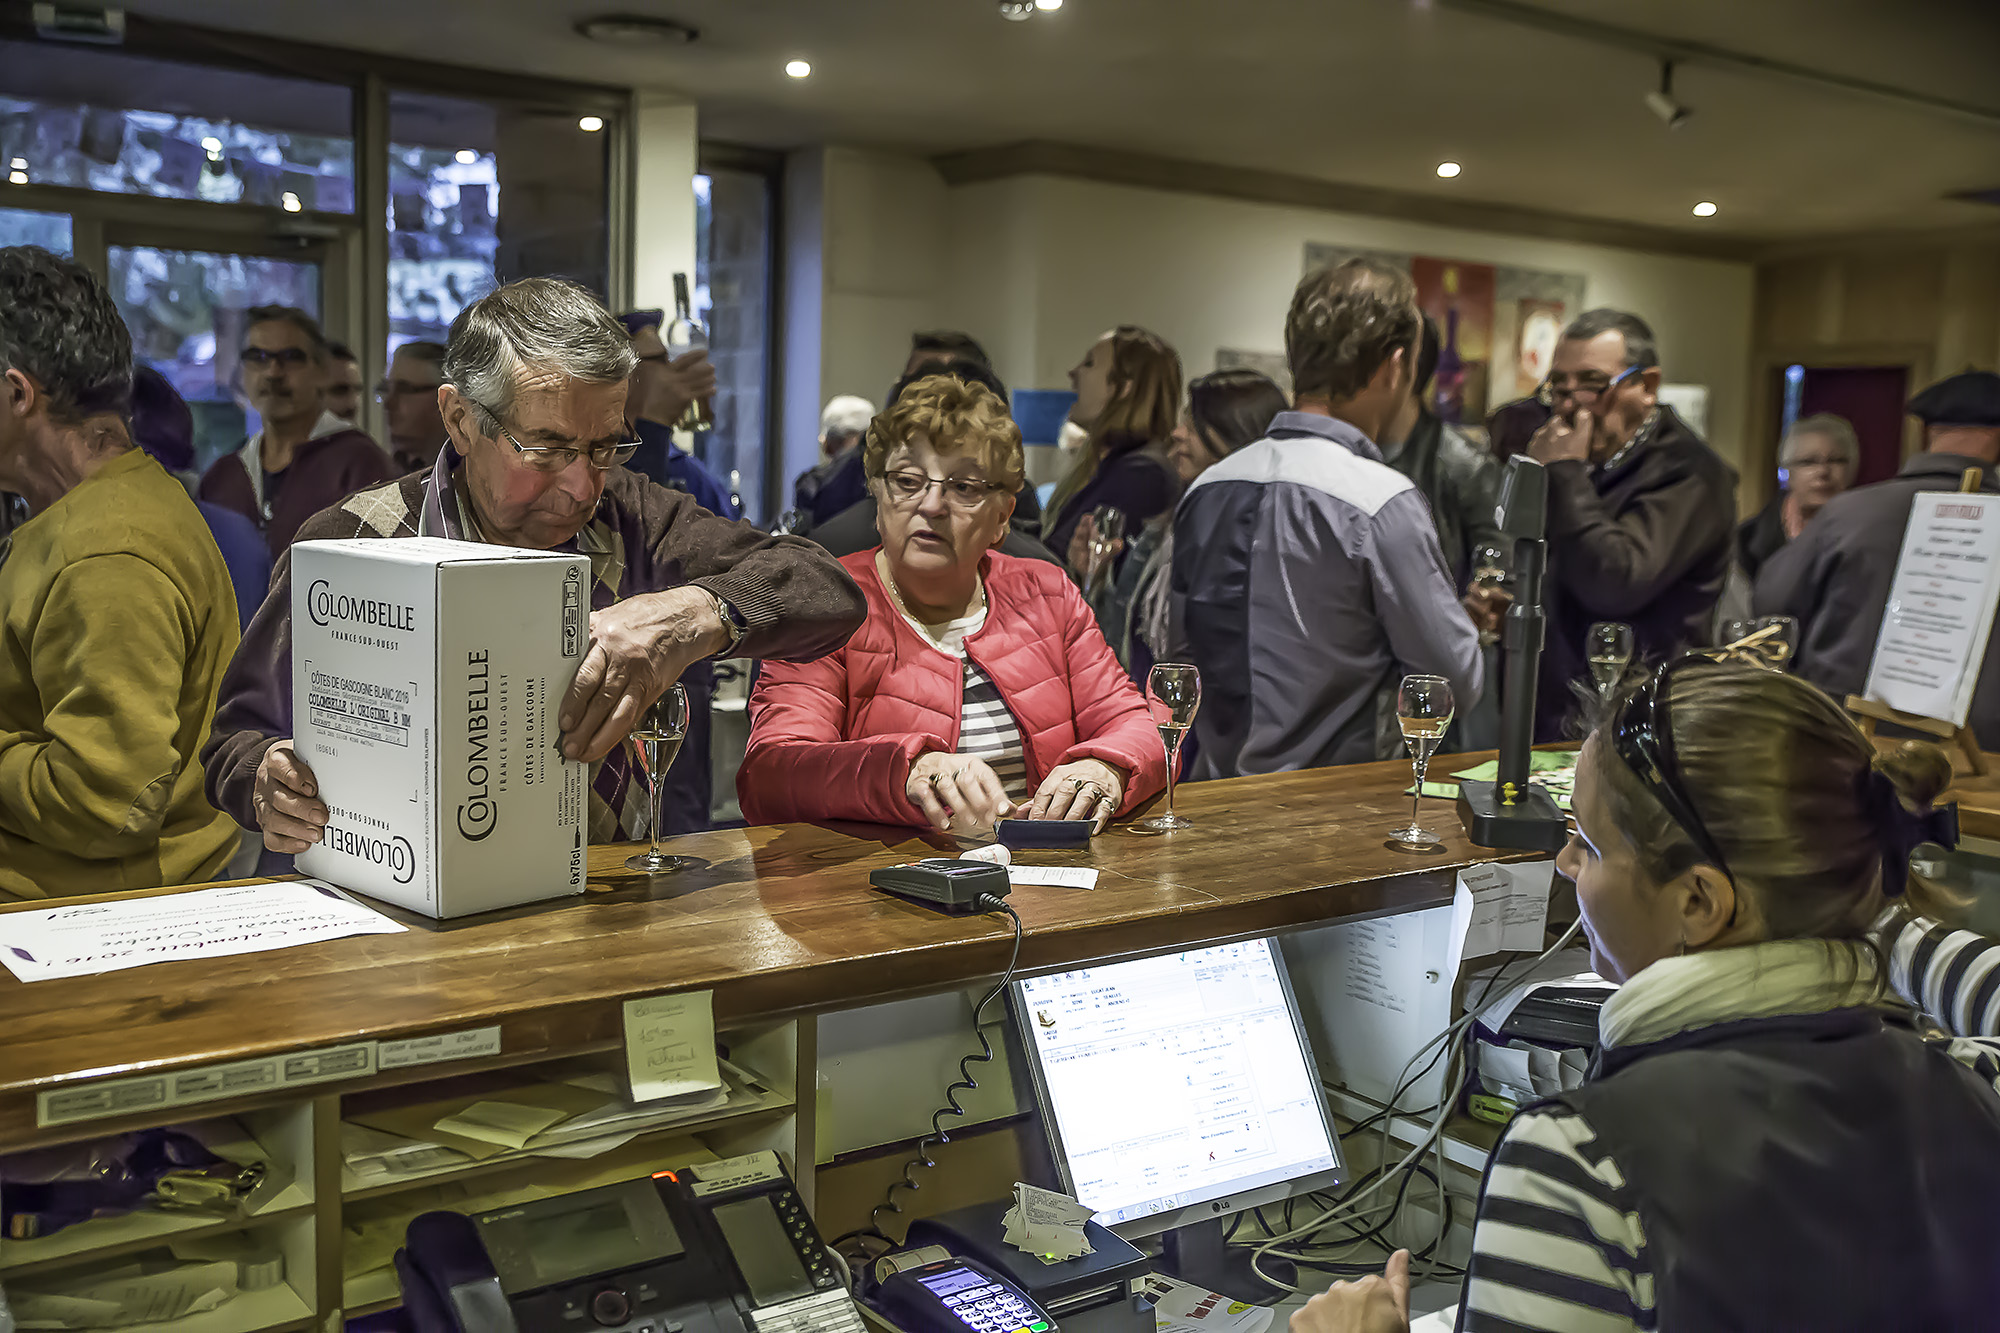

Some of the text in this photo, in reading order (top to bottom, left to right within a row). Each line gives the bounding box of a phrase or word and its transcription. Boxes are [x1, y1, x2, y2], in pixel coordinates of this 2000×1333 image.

[308, 579, 415, 631] COLOMBELLE
[331, 630, 399, 651] FRANCE SUD-OUEST
[311, 670, 331, 688] CÔTES
[331, 676, 340, 690] DE
[340, 678, 373, 697] GASCOGNE
[374, 685, 395, 701] BLANC
[308, 692, 347, 713] COLOMBELLE
[350, 702, 390, 723] L'ORIGINAL
[457, 648, 498, 842] COLOMBELLE
[500, 673, 508, 792] FRANCE SUD-OUEST
[523, 677, 535, 785] CÔTES DE GASCOGNE
[327, 804, 389, 831] FRANCE SUD-OUES
[321, 825, 416, 884] COLOMBELL
[570, 850, 581, 885] 6x75cl
[238, 913, 345, 929] Vendredi
[298, 916, 378, 932] Soirée
[101, 930, 203, 947] Octobre
[146, 930, 288, 952] Colombelle
[1220, 1201, 1230, 1209] LG
